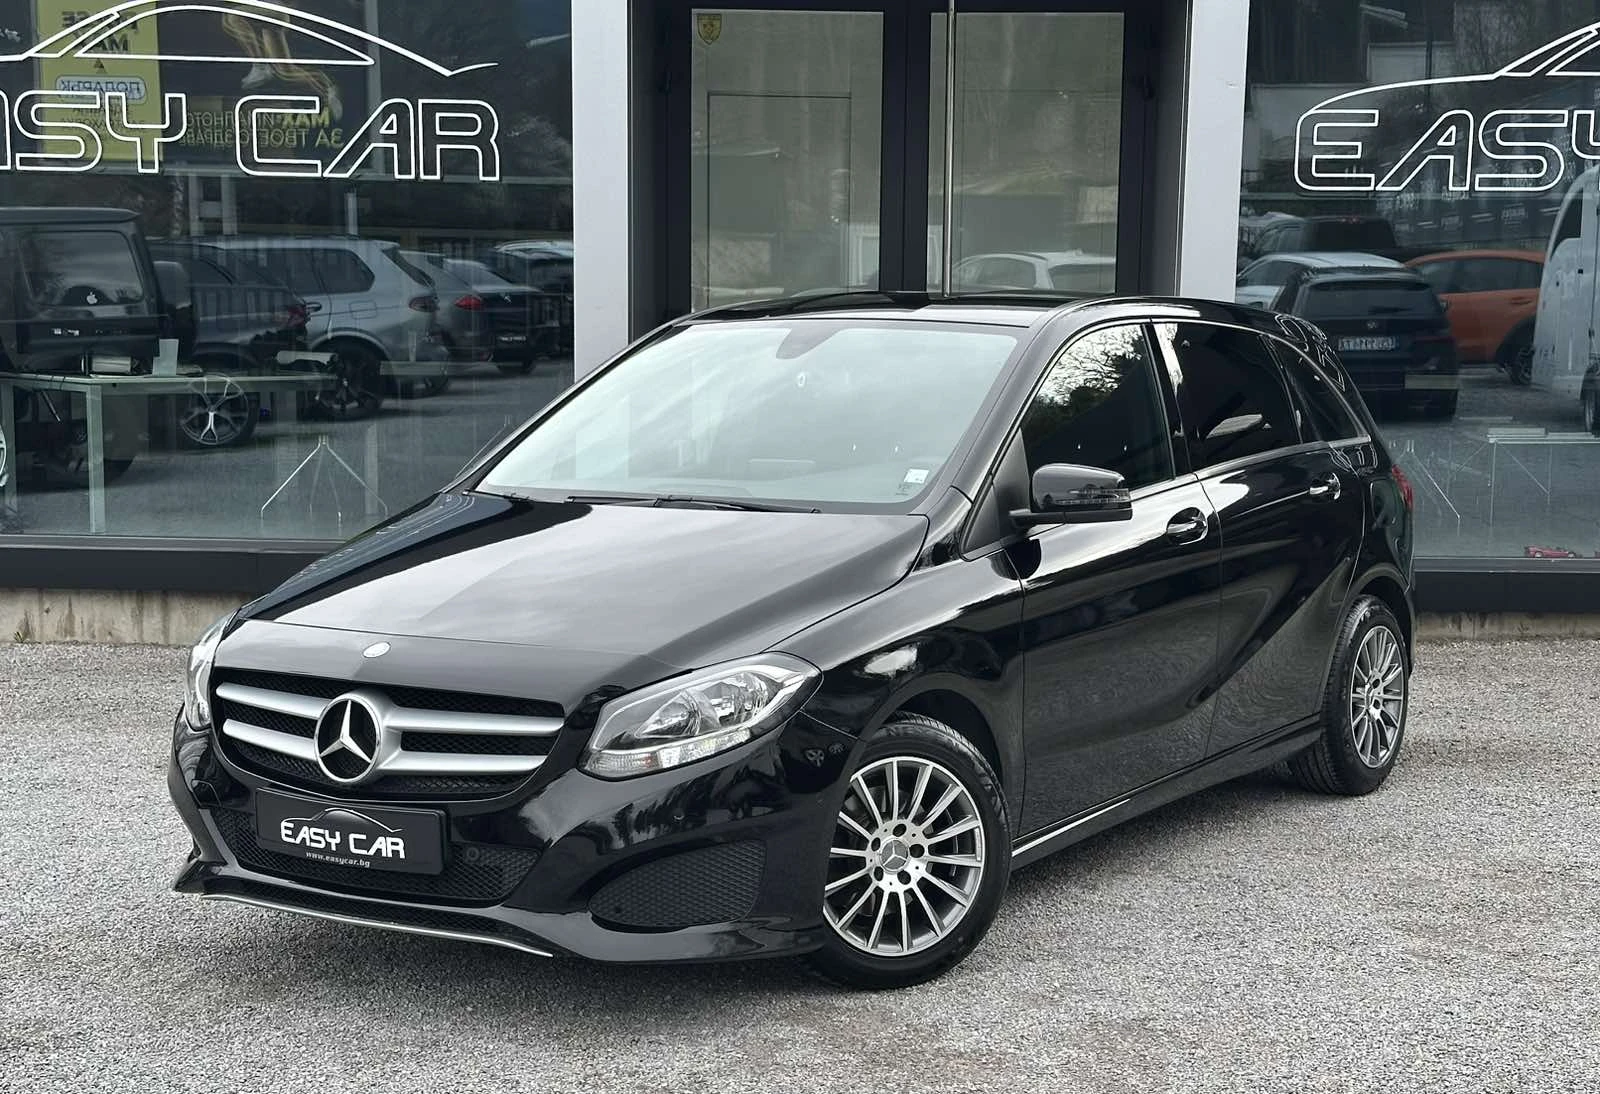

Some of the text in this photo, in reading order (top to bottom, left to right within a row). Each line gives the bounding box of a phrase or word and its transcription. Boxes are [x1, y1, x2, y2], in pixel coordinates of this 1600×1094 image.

[0, 91, 499, 180] SY CAR
[280, 821, 406, 859] EASY CAR
[306, 851, 371, 868] www.easycar.bg
